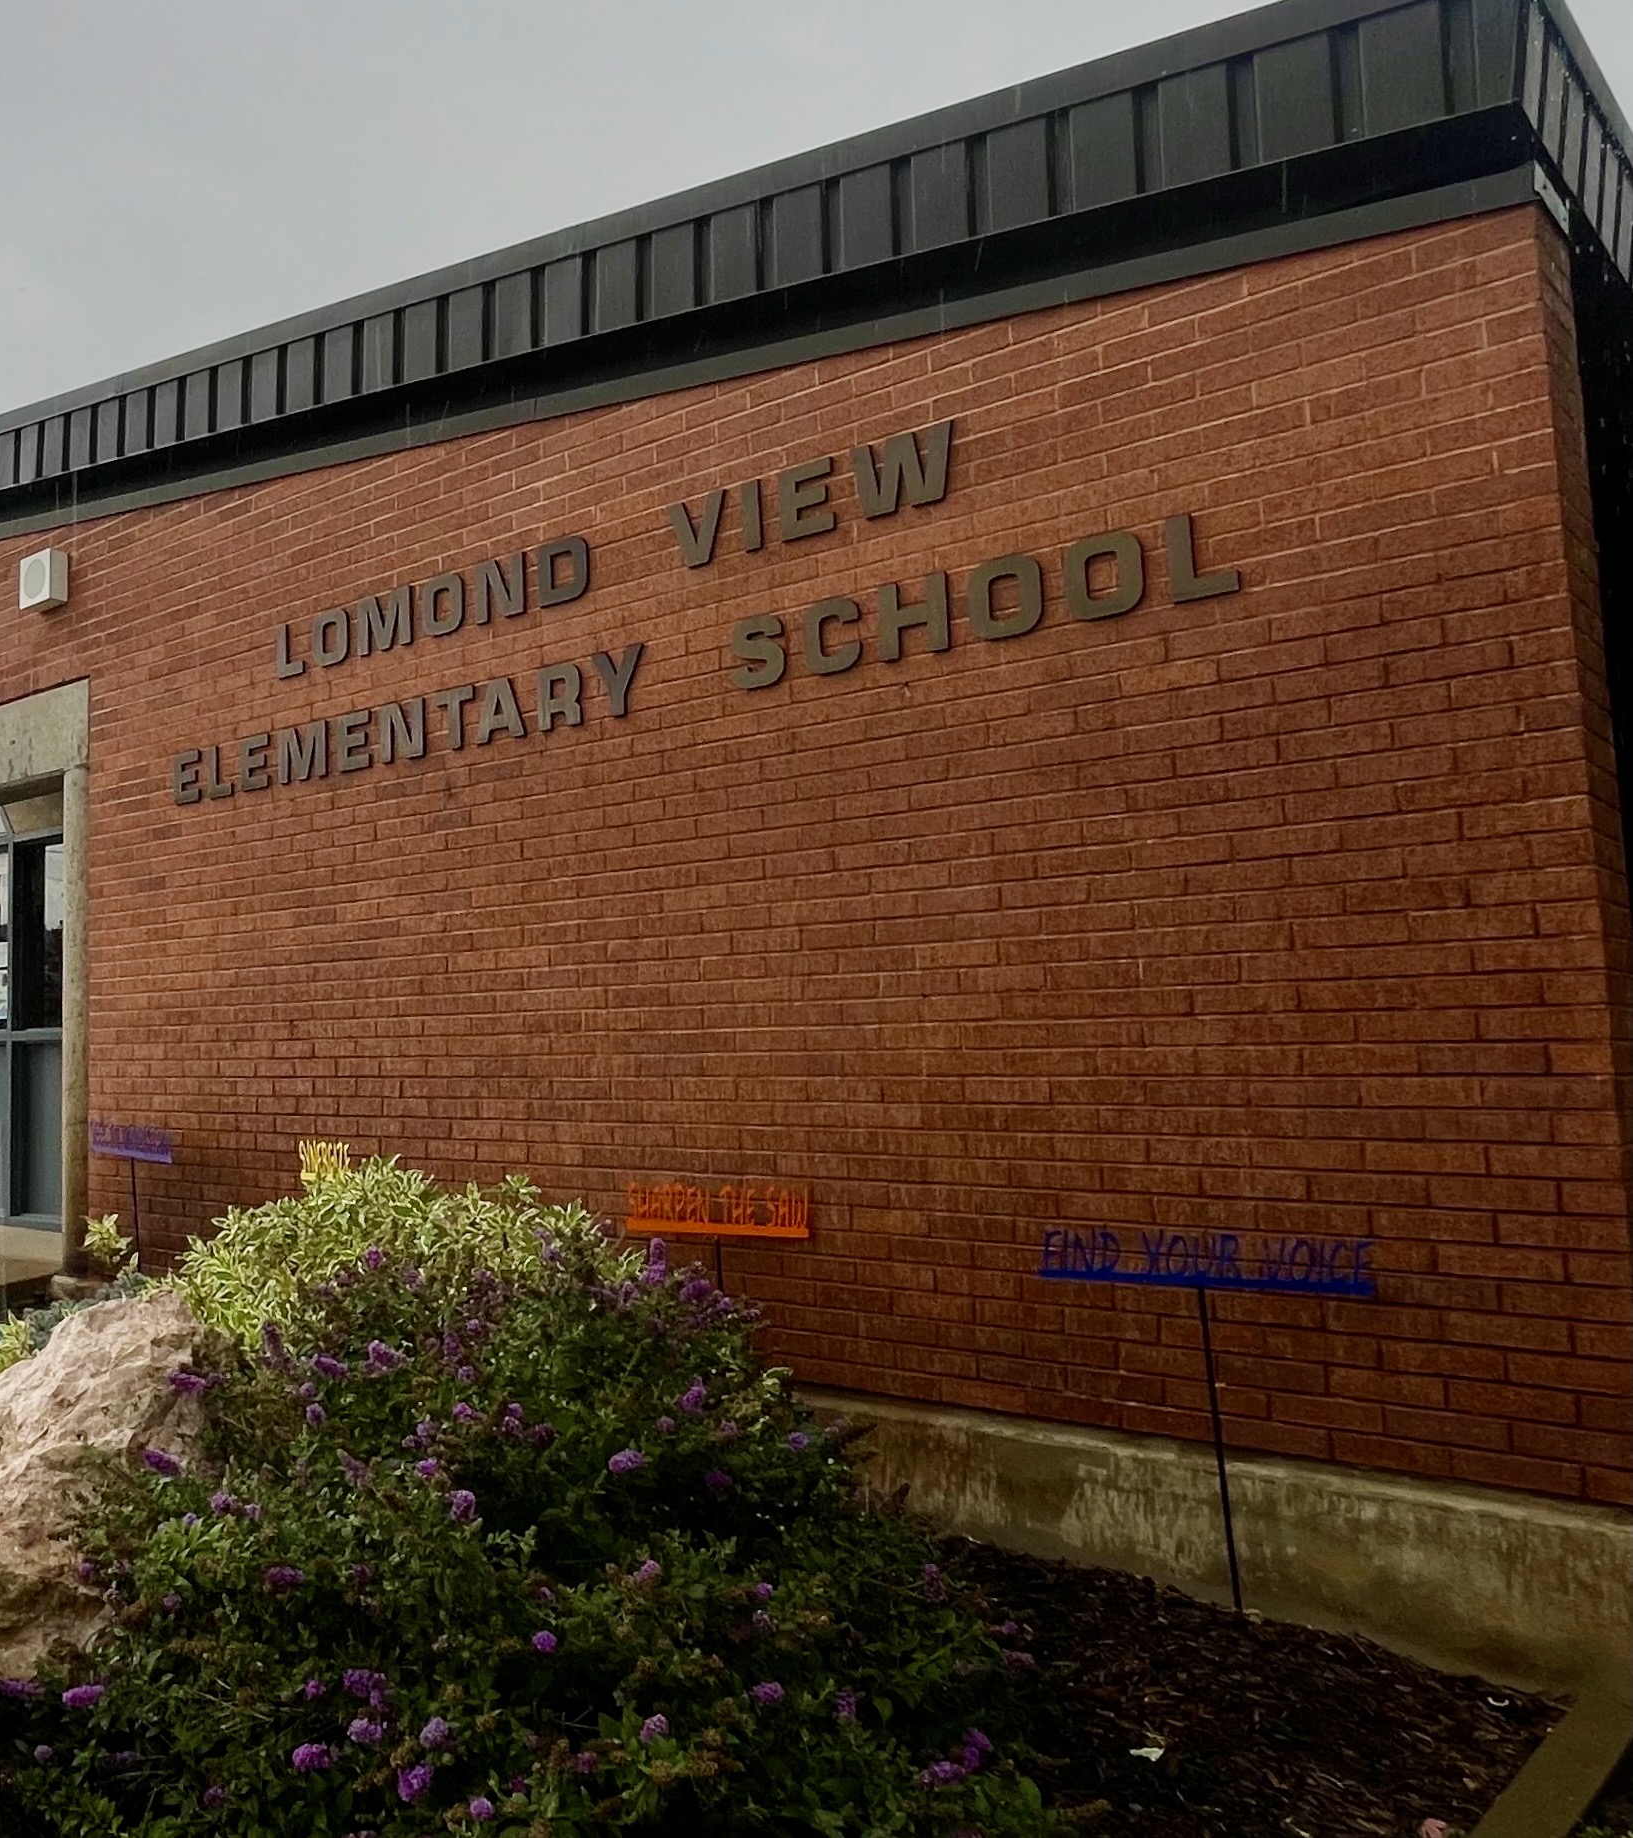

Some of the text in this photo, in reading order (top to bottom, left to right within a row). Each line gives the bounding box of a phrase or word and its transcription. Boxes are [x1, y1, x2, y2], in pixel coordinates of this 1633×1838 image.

[275, 420, 955, 680] LOMOND VIEW
[173, 513, 1242, 805] ELEMENTARY SCHOOL
[720, 1185, 756, 1227] THE
[1043, 1228, 1374, 1285] FIND YOUR VOICE
